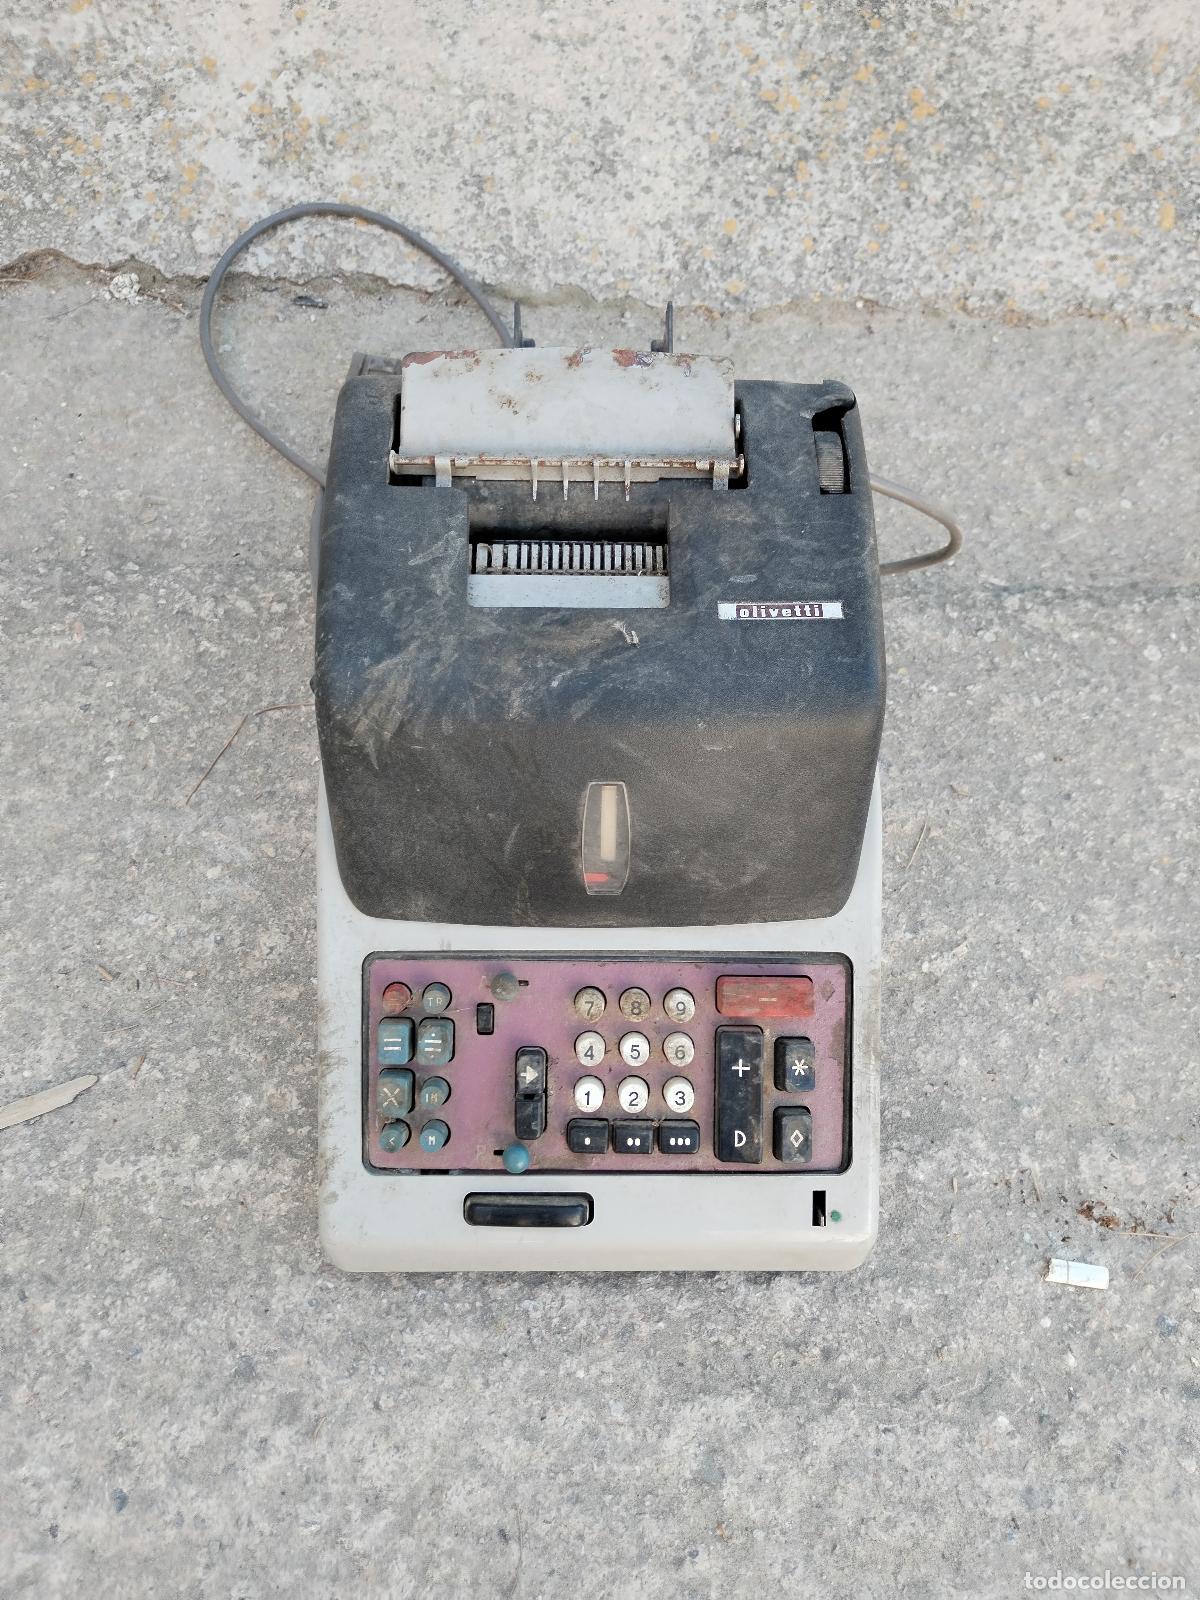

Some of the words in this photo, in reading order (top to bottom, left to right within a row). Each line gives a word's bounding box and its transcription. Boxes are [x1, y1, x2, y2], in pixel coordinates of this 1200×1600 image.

[739, 605, 820, 618] olivetti
[427, 997, 443, 1007] TR
[585, 1000, 594, 1017] 7
[630, 1001, 642, 1016] 8
[675, 1001, 687, 1016] 9
[583, 1045, 595, 1061] 4
[629, 1044, 641, 1060] 5
[674, 1045, 686, 1060] 6
[584, 1090, 591, 1106] 1
[628, 1091, 639, 1107] 2
[674, 1090, 686, 1106] 3
[428, 1135, 436, 1146] M
[734, 1130, 747, 1148] D
